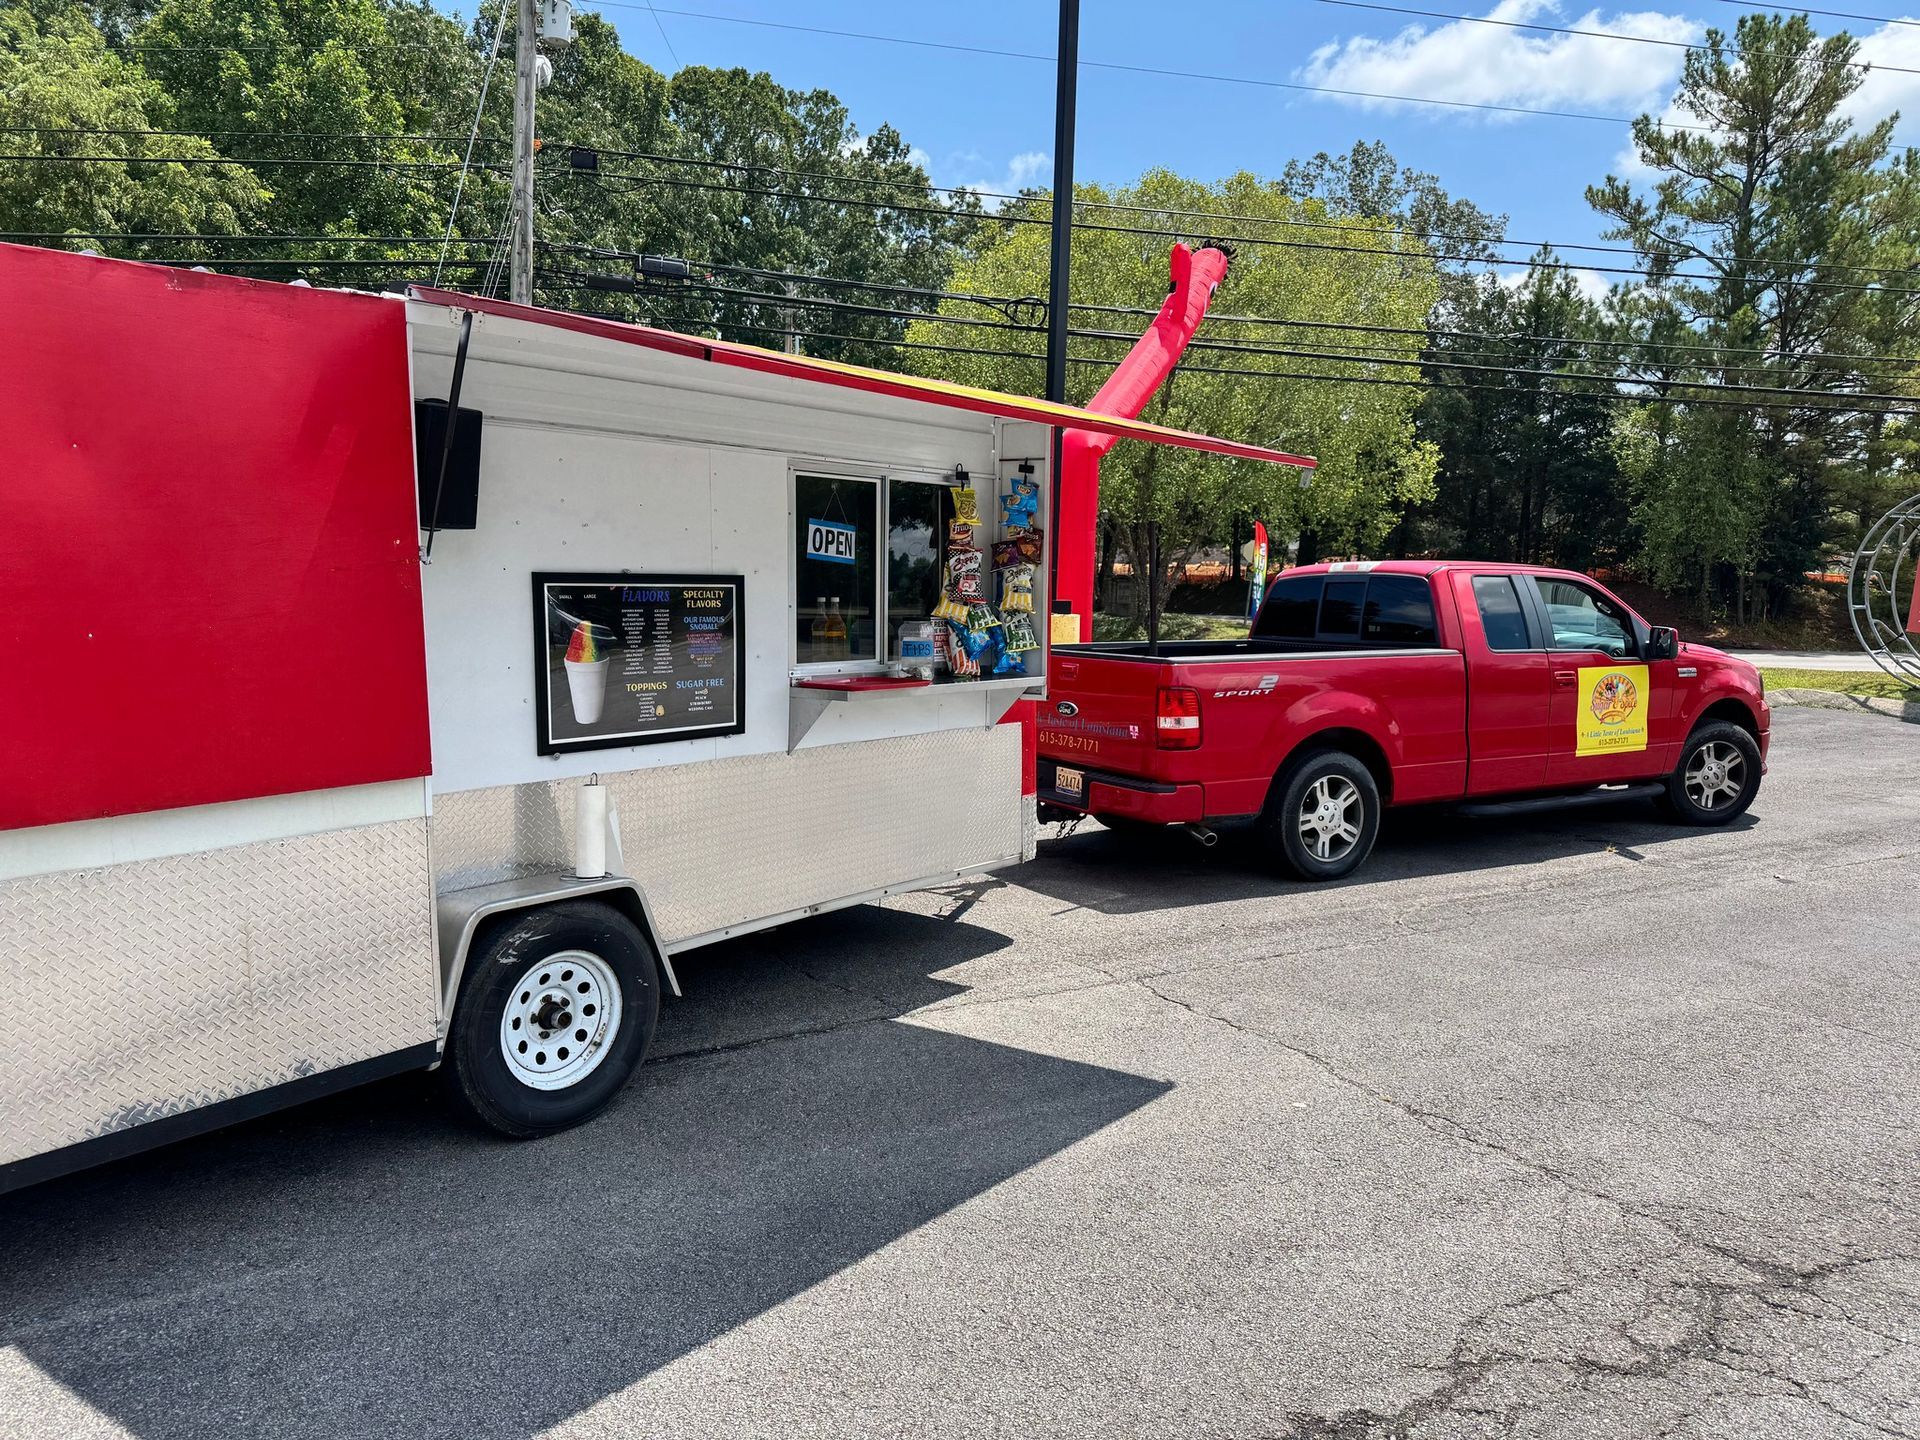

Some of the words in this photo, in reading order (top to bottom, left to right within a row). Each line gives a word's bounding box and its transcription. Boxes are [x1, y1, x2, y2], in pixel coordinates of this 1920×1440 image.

[812, 527, 852, 557] OPEN
[622, 590, 671, 602] FLAVORS
[683, 590, 724, 598] SPECIALTY
[686, 600, 722, 608] FLAVORS
[903, 642, 931, 656] TIPS
[626, 681, 668, 692] TOPPINGS
[676, 680, 703, 689] SUGAR
[706, 678, 725, 687] FREE
[1213, 689, 1273, 698] SPORT
[1058, 705, 1072, 714] Ford
[1040, 731, 1099, 753] 615-378-7171
